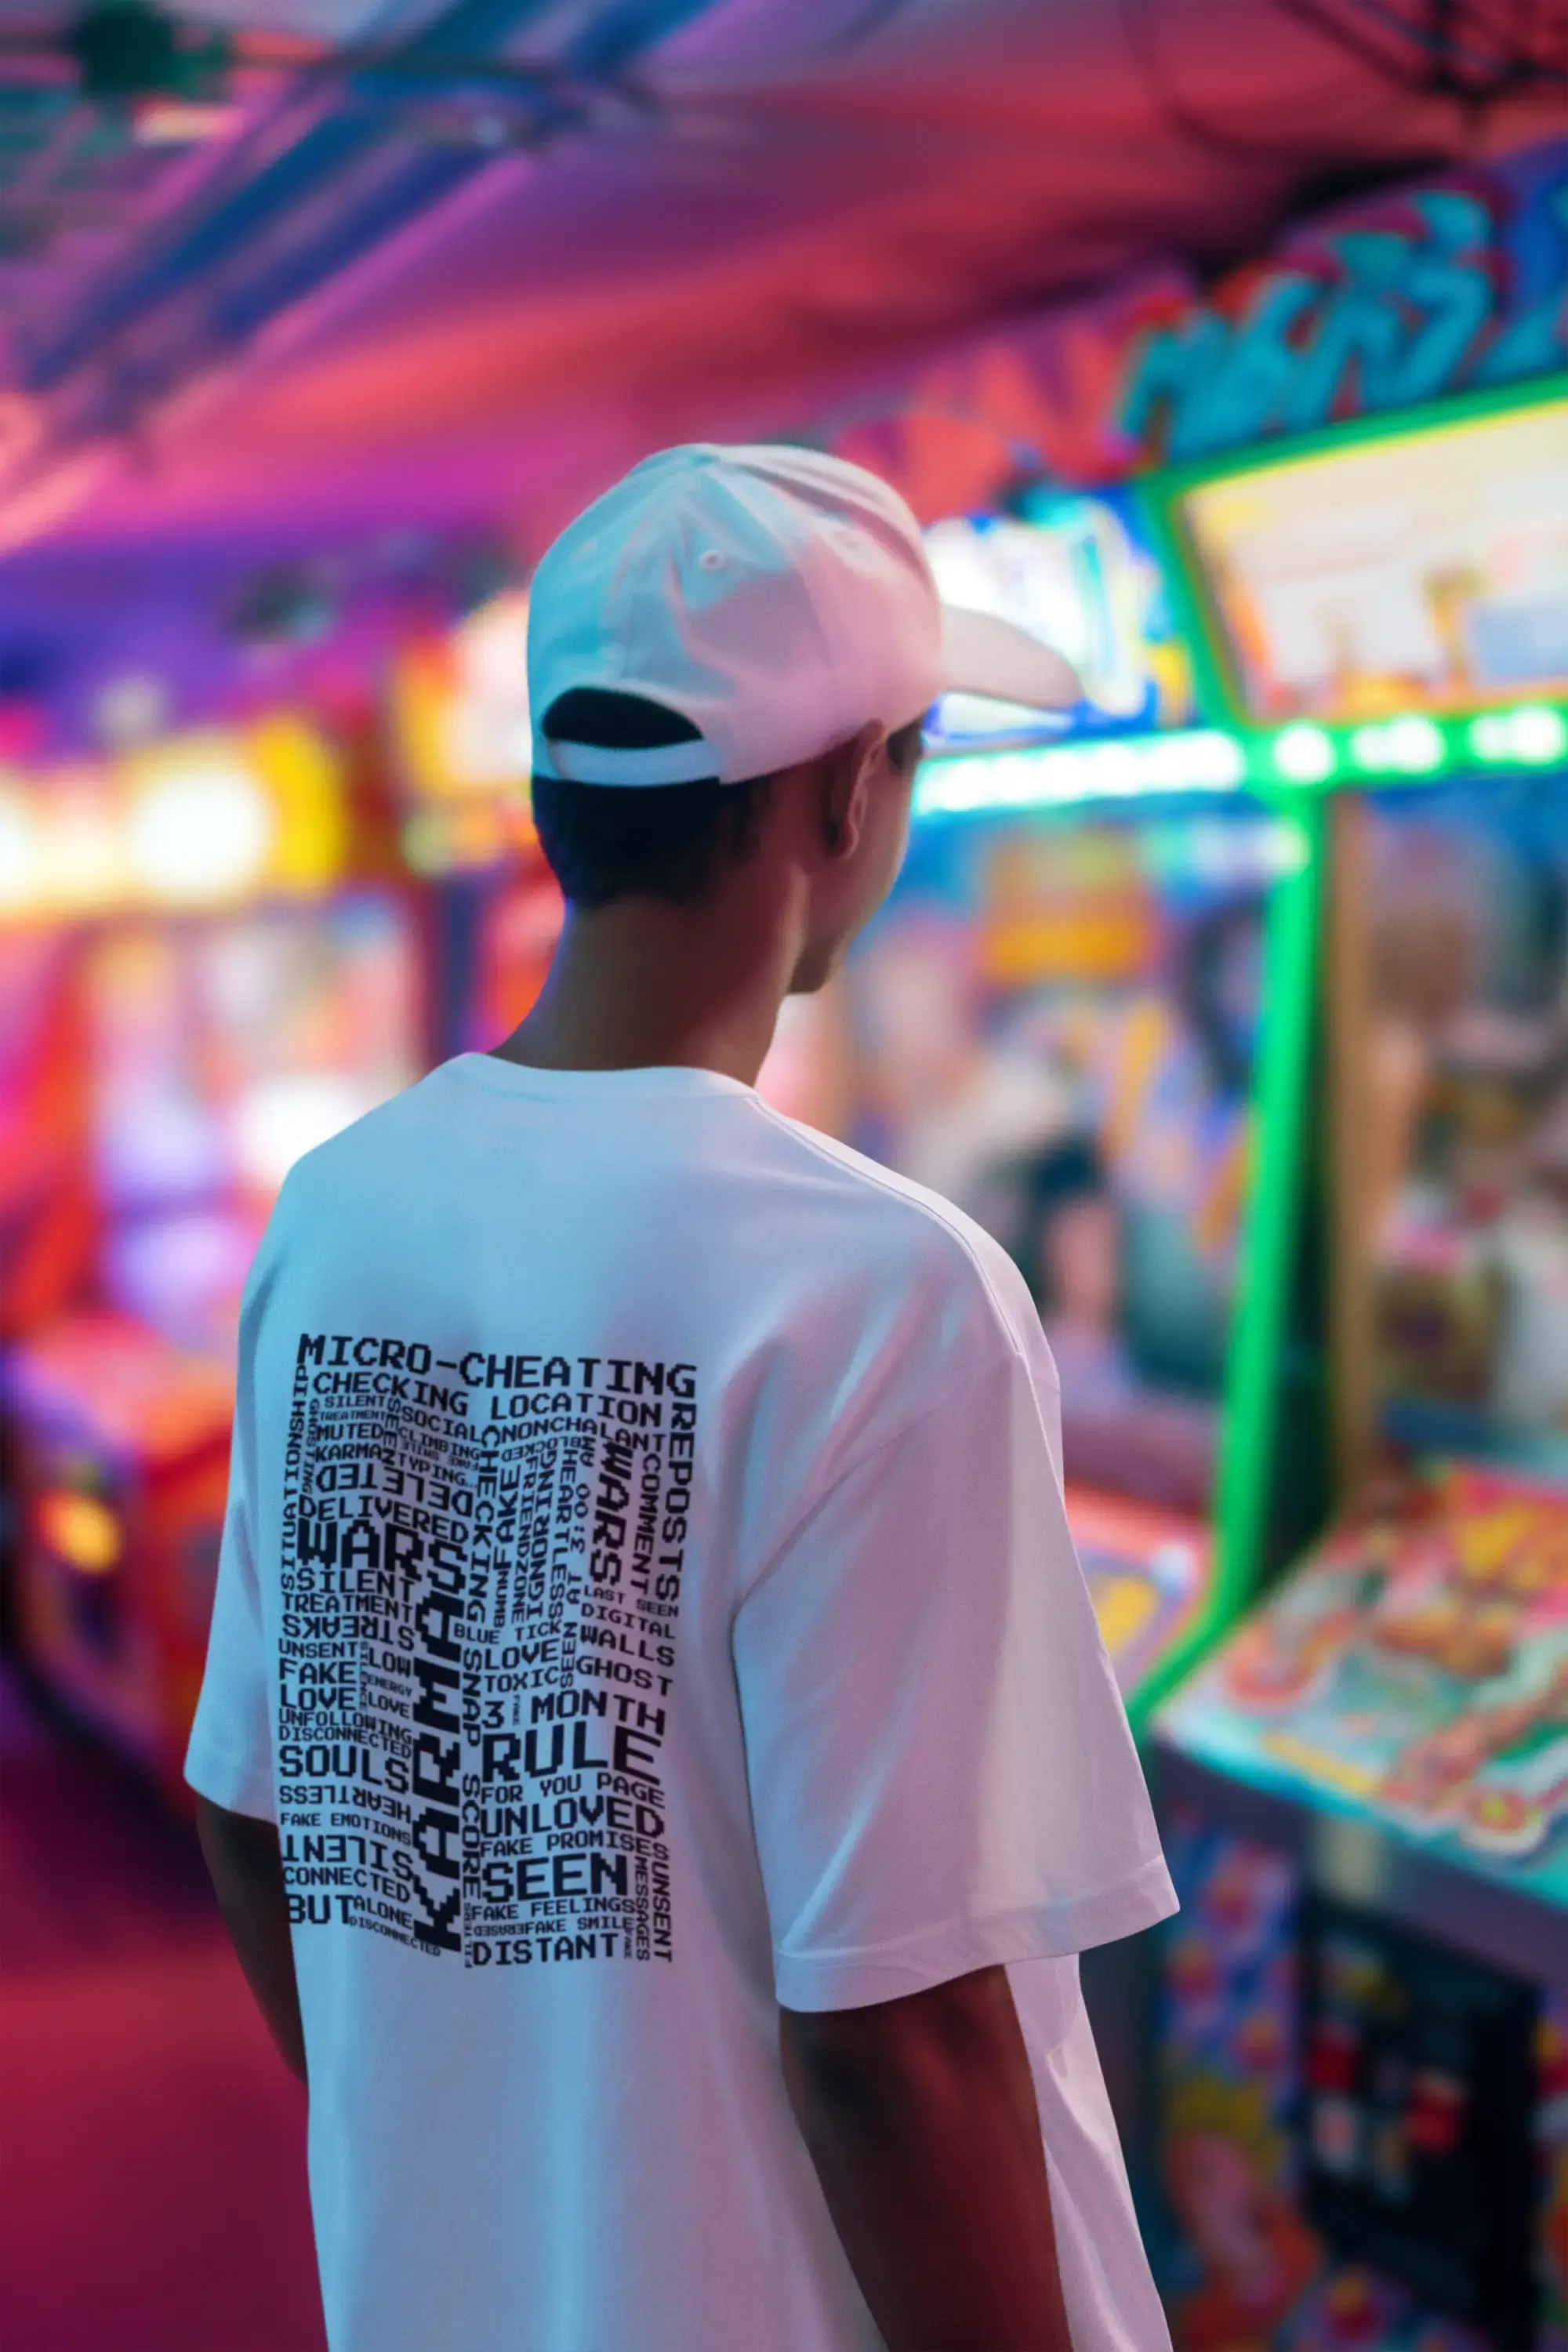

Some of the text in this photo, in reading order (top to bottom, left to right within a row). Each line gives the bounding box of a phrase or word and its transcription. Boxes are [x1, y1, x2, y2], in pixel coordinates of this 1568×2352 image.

[296, 1334, 697, 1399] MICRO-CHEATING
[313, 1372, 662, 1427] CHECKING LOCATION
[324, 1395, 385, 1408] SILENT
[303, 1398, 320, 1495] GHOSTING
[316, 1423, 384, 1441] MUTED
[381, 1397, 401, 1466] SEEN
[398, 1405, 482, 1460] SOCIAL CLIMBING
[502, 1417, 666, 1452] NONCHALANT
[502, 1436, 583, 1463] BLOCKED
[315, 1443, 382, 1462] KARMA
[281, 1363, 309, 1591] SITUATIONSHIP
[316, 1463, 473, 1518] DELETED
[299, 1494, 469, 1544] DELIVERED
[493, 1465, 521, 1570] FAKE
[590, 1442, 633, 1586] WARS
[655, 1403, 697, 1602] REPOSTS
[466, 1425, 501, 1624] CHECKING
[512, 1456, 539, 1624] FRIENDZONE
[527, 1450, 557, 1621] IGNORING
[548, 1449, 579, 1619] HEARTLESS
[630, 1454, 662, 1595] COMMENT
[296, 1518, 469, 1595] WARS
[296, 1567, 414, 1602] SILENT
[493, 1570, 509, 1628] NUMB
[566, 1572, 583, 1605] AT
[584, 1585, 679, 1617] LAST SEEN
[281, 1592, 413, 1623] TREATMENT
[581, 1603, 676, 1639] DIGITAL
[278, 1638, 358, 1658] UNSENT
[282, 1614, 415, 1650] STREAKS
[454, 1620, 561, 1645] BLUE TICK
[580, 1624, 675, 1668] WALLS
[369, 1647, 411, 1679] LOW
[485, 1639, 560, 1670] LOVE
[561, 1622, 578, 1689] SEEN
[279, 1658, 358, 1711] FAKE LOVE
[485, 1666, 561, 1693] TOXIC
[576, 1656, 673, 1697] GHOST
[368, 1691, 410, 1719] LOVE
[279, 1708, 413, 1744] UNFOLLOWING
[279, 1726, 412, 1759] DISCONNECTED
[481, 1689, 665, 1785] 3 MONTH RULE
[279, 1744, 409, 1795] SOULS
[412, 1590, 465, 1953] KARMA
[463, 1648, 482, 1900] SNAP SCORE
[279, 1785, 411, 1824] HEARTLESS
[481, 1772, 665, 1809] FOR YOU PAGE
[281, 1813, 412, 1846] FAKE EMOTIONS
[481, 1795, 664, 1839] UNLOVED
[282, 1835, 415, 1882] SILENT
[481, 1837, 533, 1857] FAKE
[283, 1867, 410, 1904] CONNECTED
[482, 1852, 627, 1903] SEEN
[289, 1894, 354, 1925] BUT
[353, 1895, 413, 1930] ALONE
[471, 1897, 635, 1922] FAKE FEELINGS
[525, 1918, 567, 1935] FAKE
[634, 1856, 651, 1961] MESSAGES
[349, 1916, 441, 1957] DISCONNECTED
[473, 1933, 619, 1965] DISTANT
